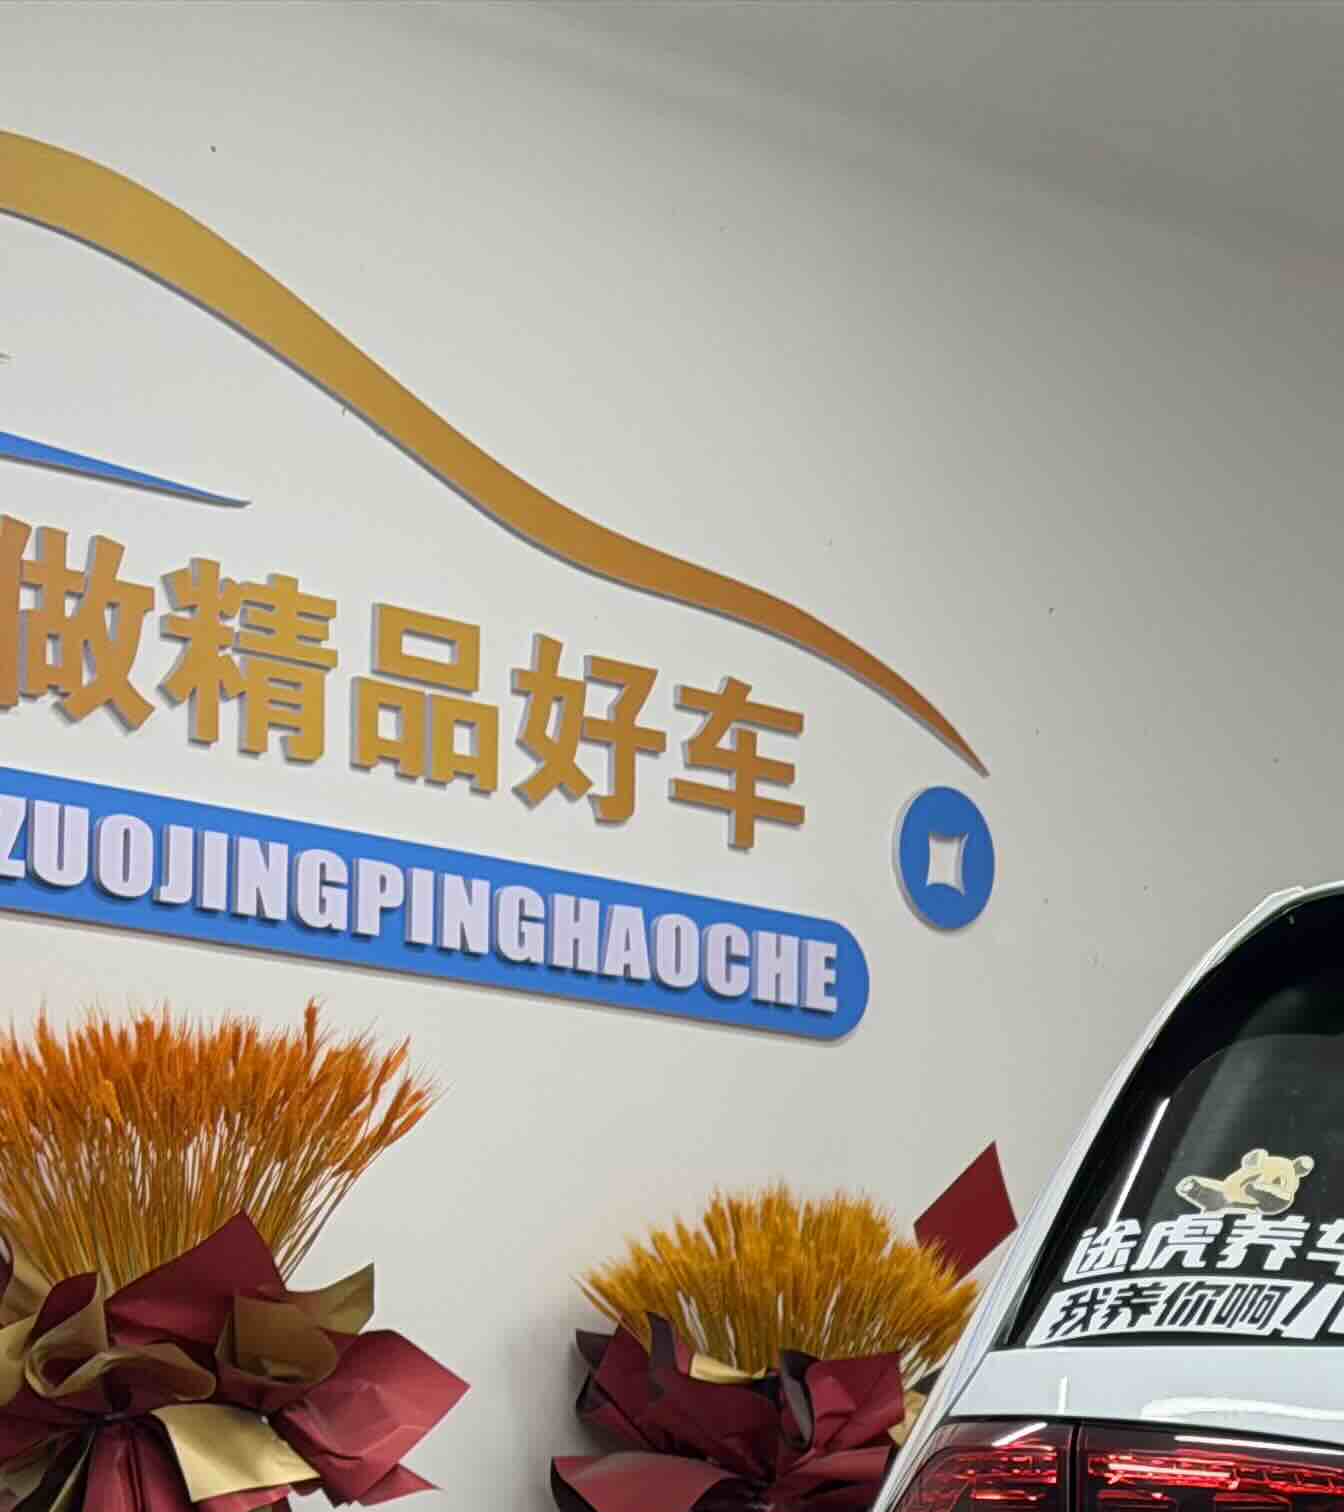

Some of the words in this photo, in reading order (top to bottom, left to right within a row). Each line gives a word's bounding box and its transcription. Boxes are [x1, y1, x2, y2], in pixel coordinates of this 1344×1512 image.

[0, 513, 806, 850] 做精品好车
